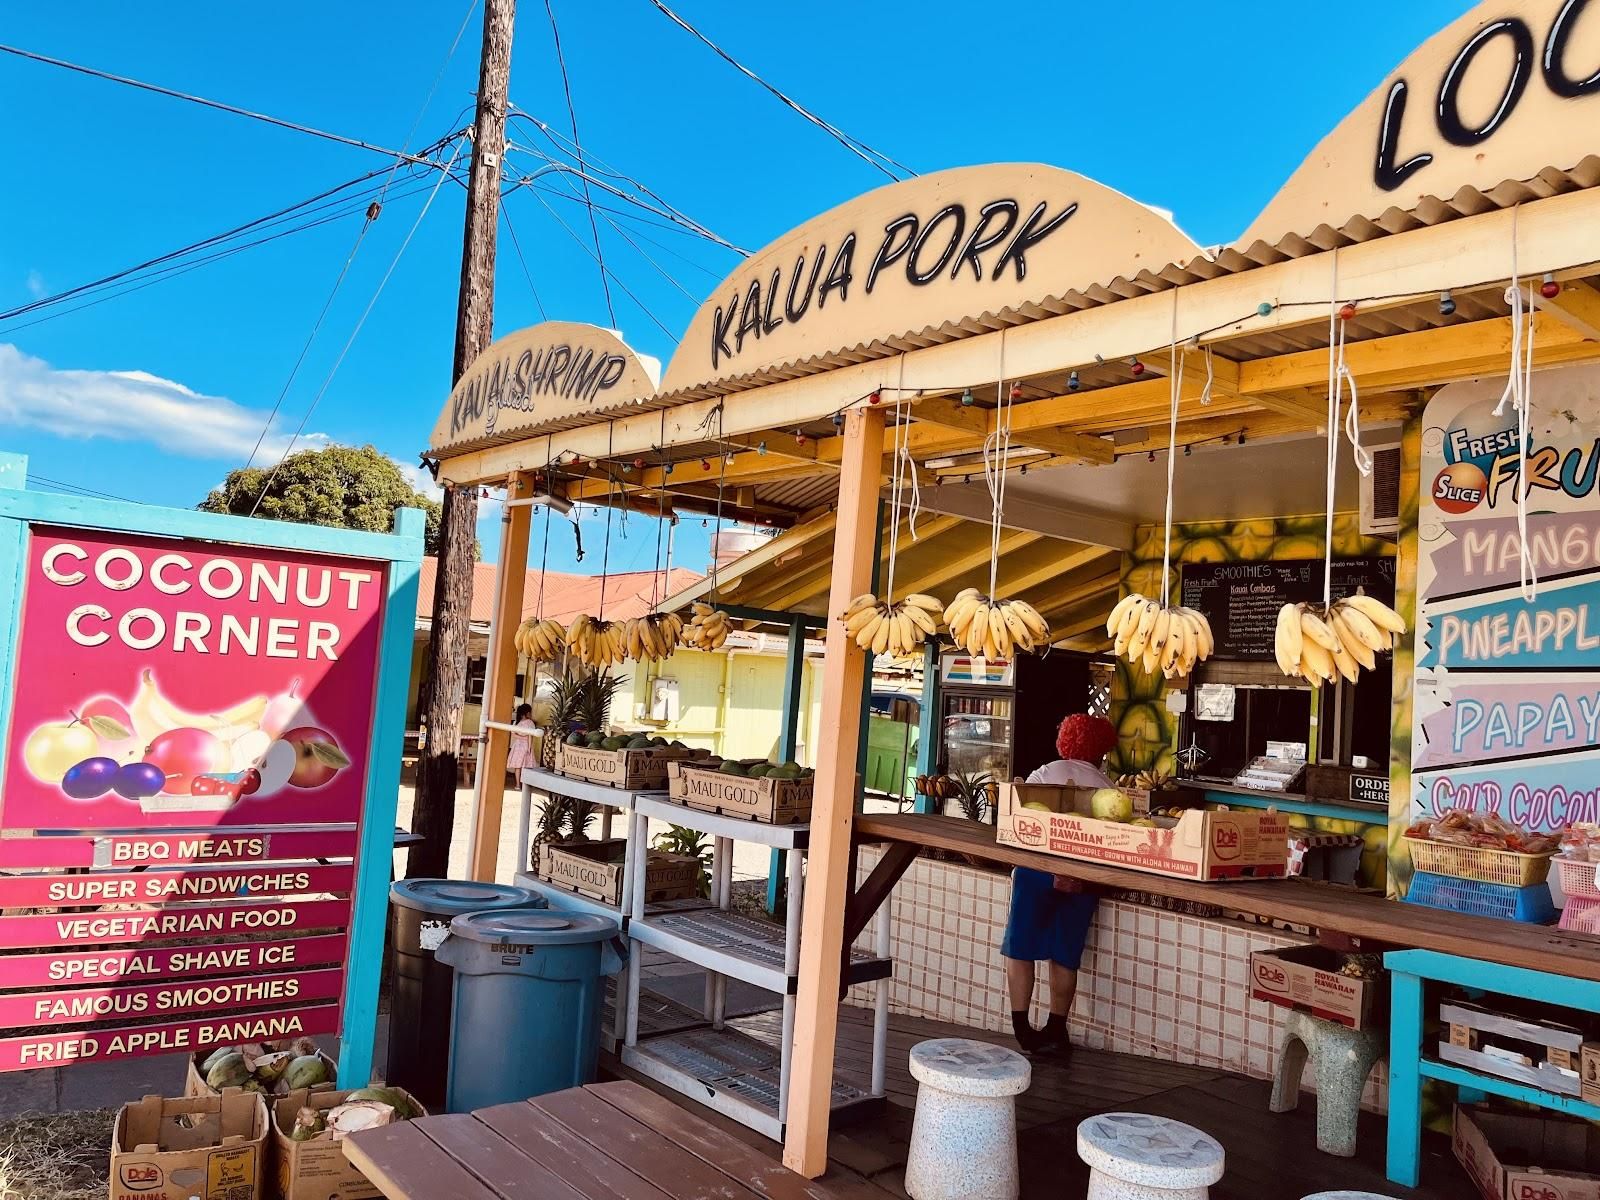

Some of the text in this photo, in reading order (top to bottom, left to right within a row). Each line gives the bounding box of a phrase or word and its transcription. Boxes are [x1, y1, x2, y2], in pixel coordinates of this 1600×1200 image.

[711, 198, 1079, 370] KALUA PORK
[513, 343, 626, 403] SHRIMP
[1449, 427, 1523, 463] FRESH
[1435, 475, 1480, 503] SLICE
[41, 543, 372, 611] COCONUT
[1214, 565, 1272, 580] SMOOTHIES
[66, 604, 342, 661] CORNER
[1439, 604, 1600, 664] PINEAPPL
[1453, 693, 1600, 753] PAPAY
[566, 753, 616, 774] MAUI GOLD
[690, 779, 759, 806] MAUI GOLD
[1018, 820, 1042, 835] Dole
[1050, 817, 1083, 831] ROYAL
[1050, 828, 1103, 845] HAWAIIAN
[1217, 828, 1238, 844] Dole
[114, 838, 263, 861] BBQ MEATS
[1053, 842, 1071, 851] SWEET
[1071, 845, 1101, 857] PINEAPPLE
[1104, 851, 1126, 861] GROWN
[1126, 854, 1141, 864] WITH
[1142, 856, 1161, 867] ALOHA
[1163, 862, 1171, 870] IN
[48, 873, 310, 901] SUPER SANDWICHES
[555, 859, 579, 878] MAUI
[580, 867, 607, 888] GOLD
[56, 908, 297, 940] VEGETARIAN FOOD
[48, 945, 295, 980] SPECIAL SHAVE ICE
[491, 943, 534, 955] BRUTE
[1259, 965, 1285, 982] Dole
[1314, 971, 1340, 983] ROYAL
[1314, 978, 1356, 995] HAWAIIAN
[34, 979, 299, 1019] FAMOUS SMOOTHIES
[20, 1016, 303, 1064] FRIED APPLE BANANA
[128, 1167, 158, 1180] Dole
[119, 1192, 168, 1200] BANANAS
[1521, 1185, 1558, 1200] Dole
